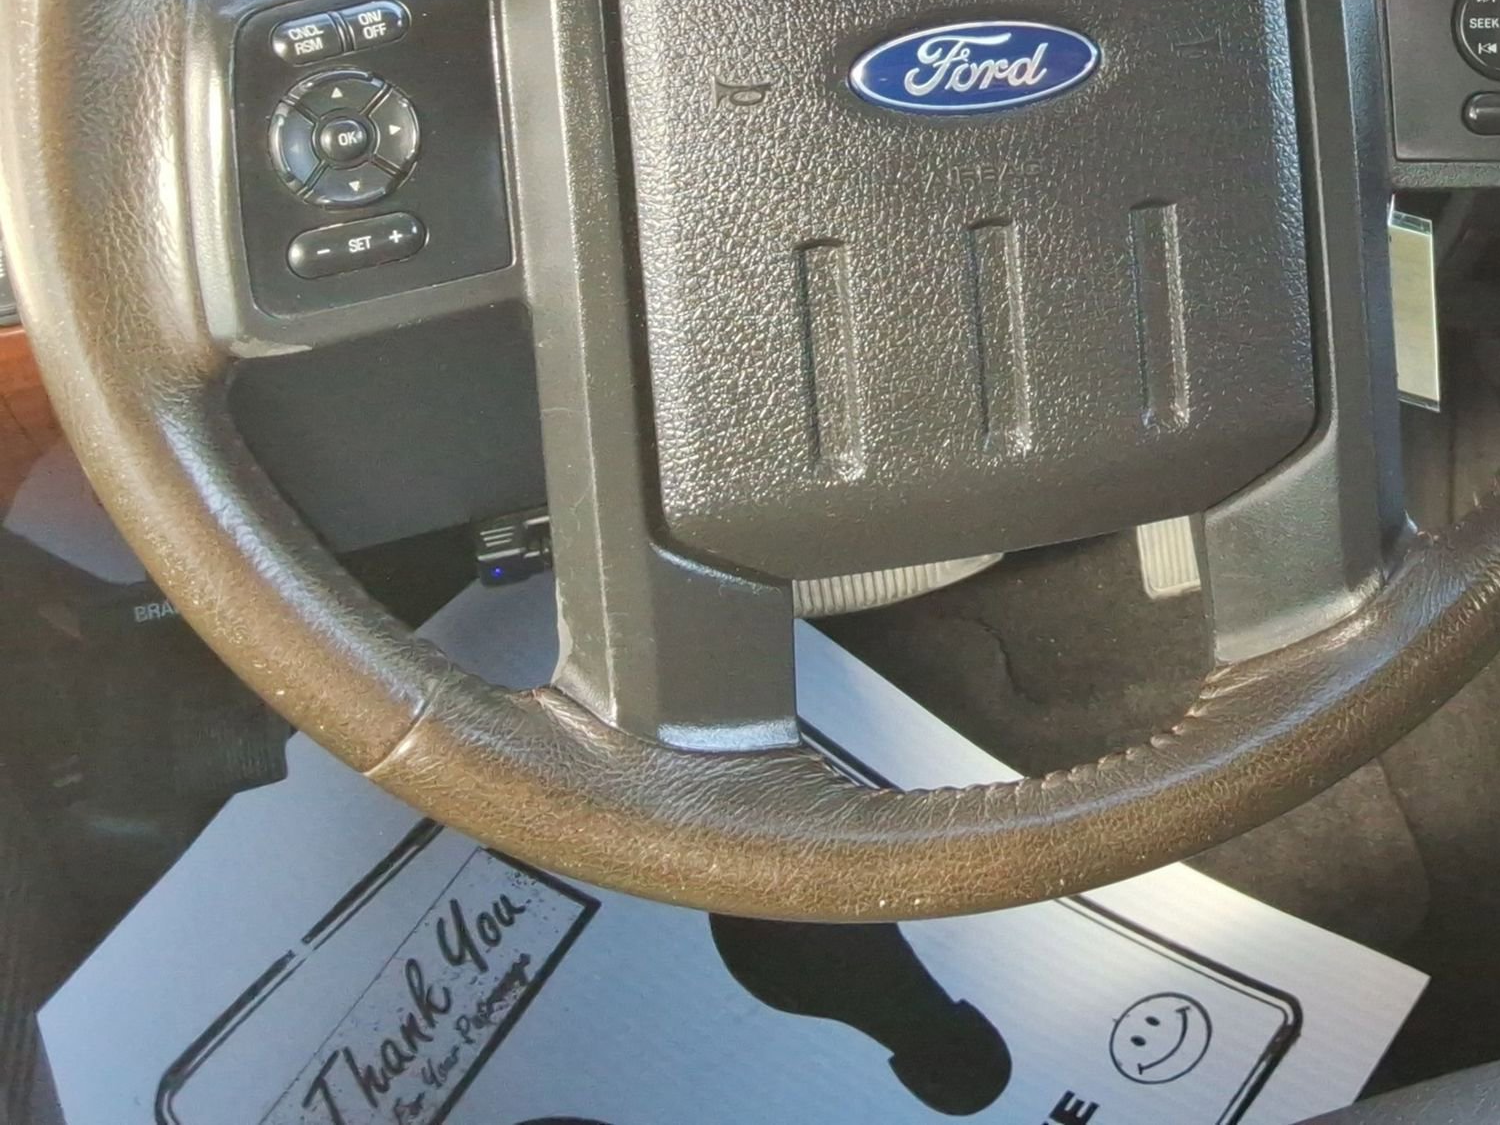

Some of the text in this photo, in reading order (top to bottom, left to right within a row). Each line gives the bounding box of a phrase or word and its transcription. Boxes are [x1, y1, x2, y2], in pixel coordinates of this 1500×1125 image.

[358, 9, 383, 26] ON/
[1469, 17, 1499, 29] SEEK
[288, 24, 325, 42] CNCL
[362, 23, 388, 40] OFF
[294, 39, 325, 56] RSM
[903, 32, 1049, 97] Ford
[337, 131, 358, 147] OK
[348, 235, 372, 253] SET
[133, 601, 177, 623] BRA
[302, 957, 454, 1125] Thank
[436, 893, 527, 973] You
